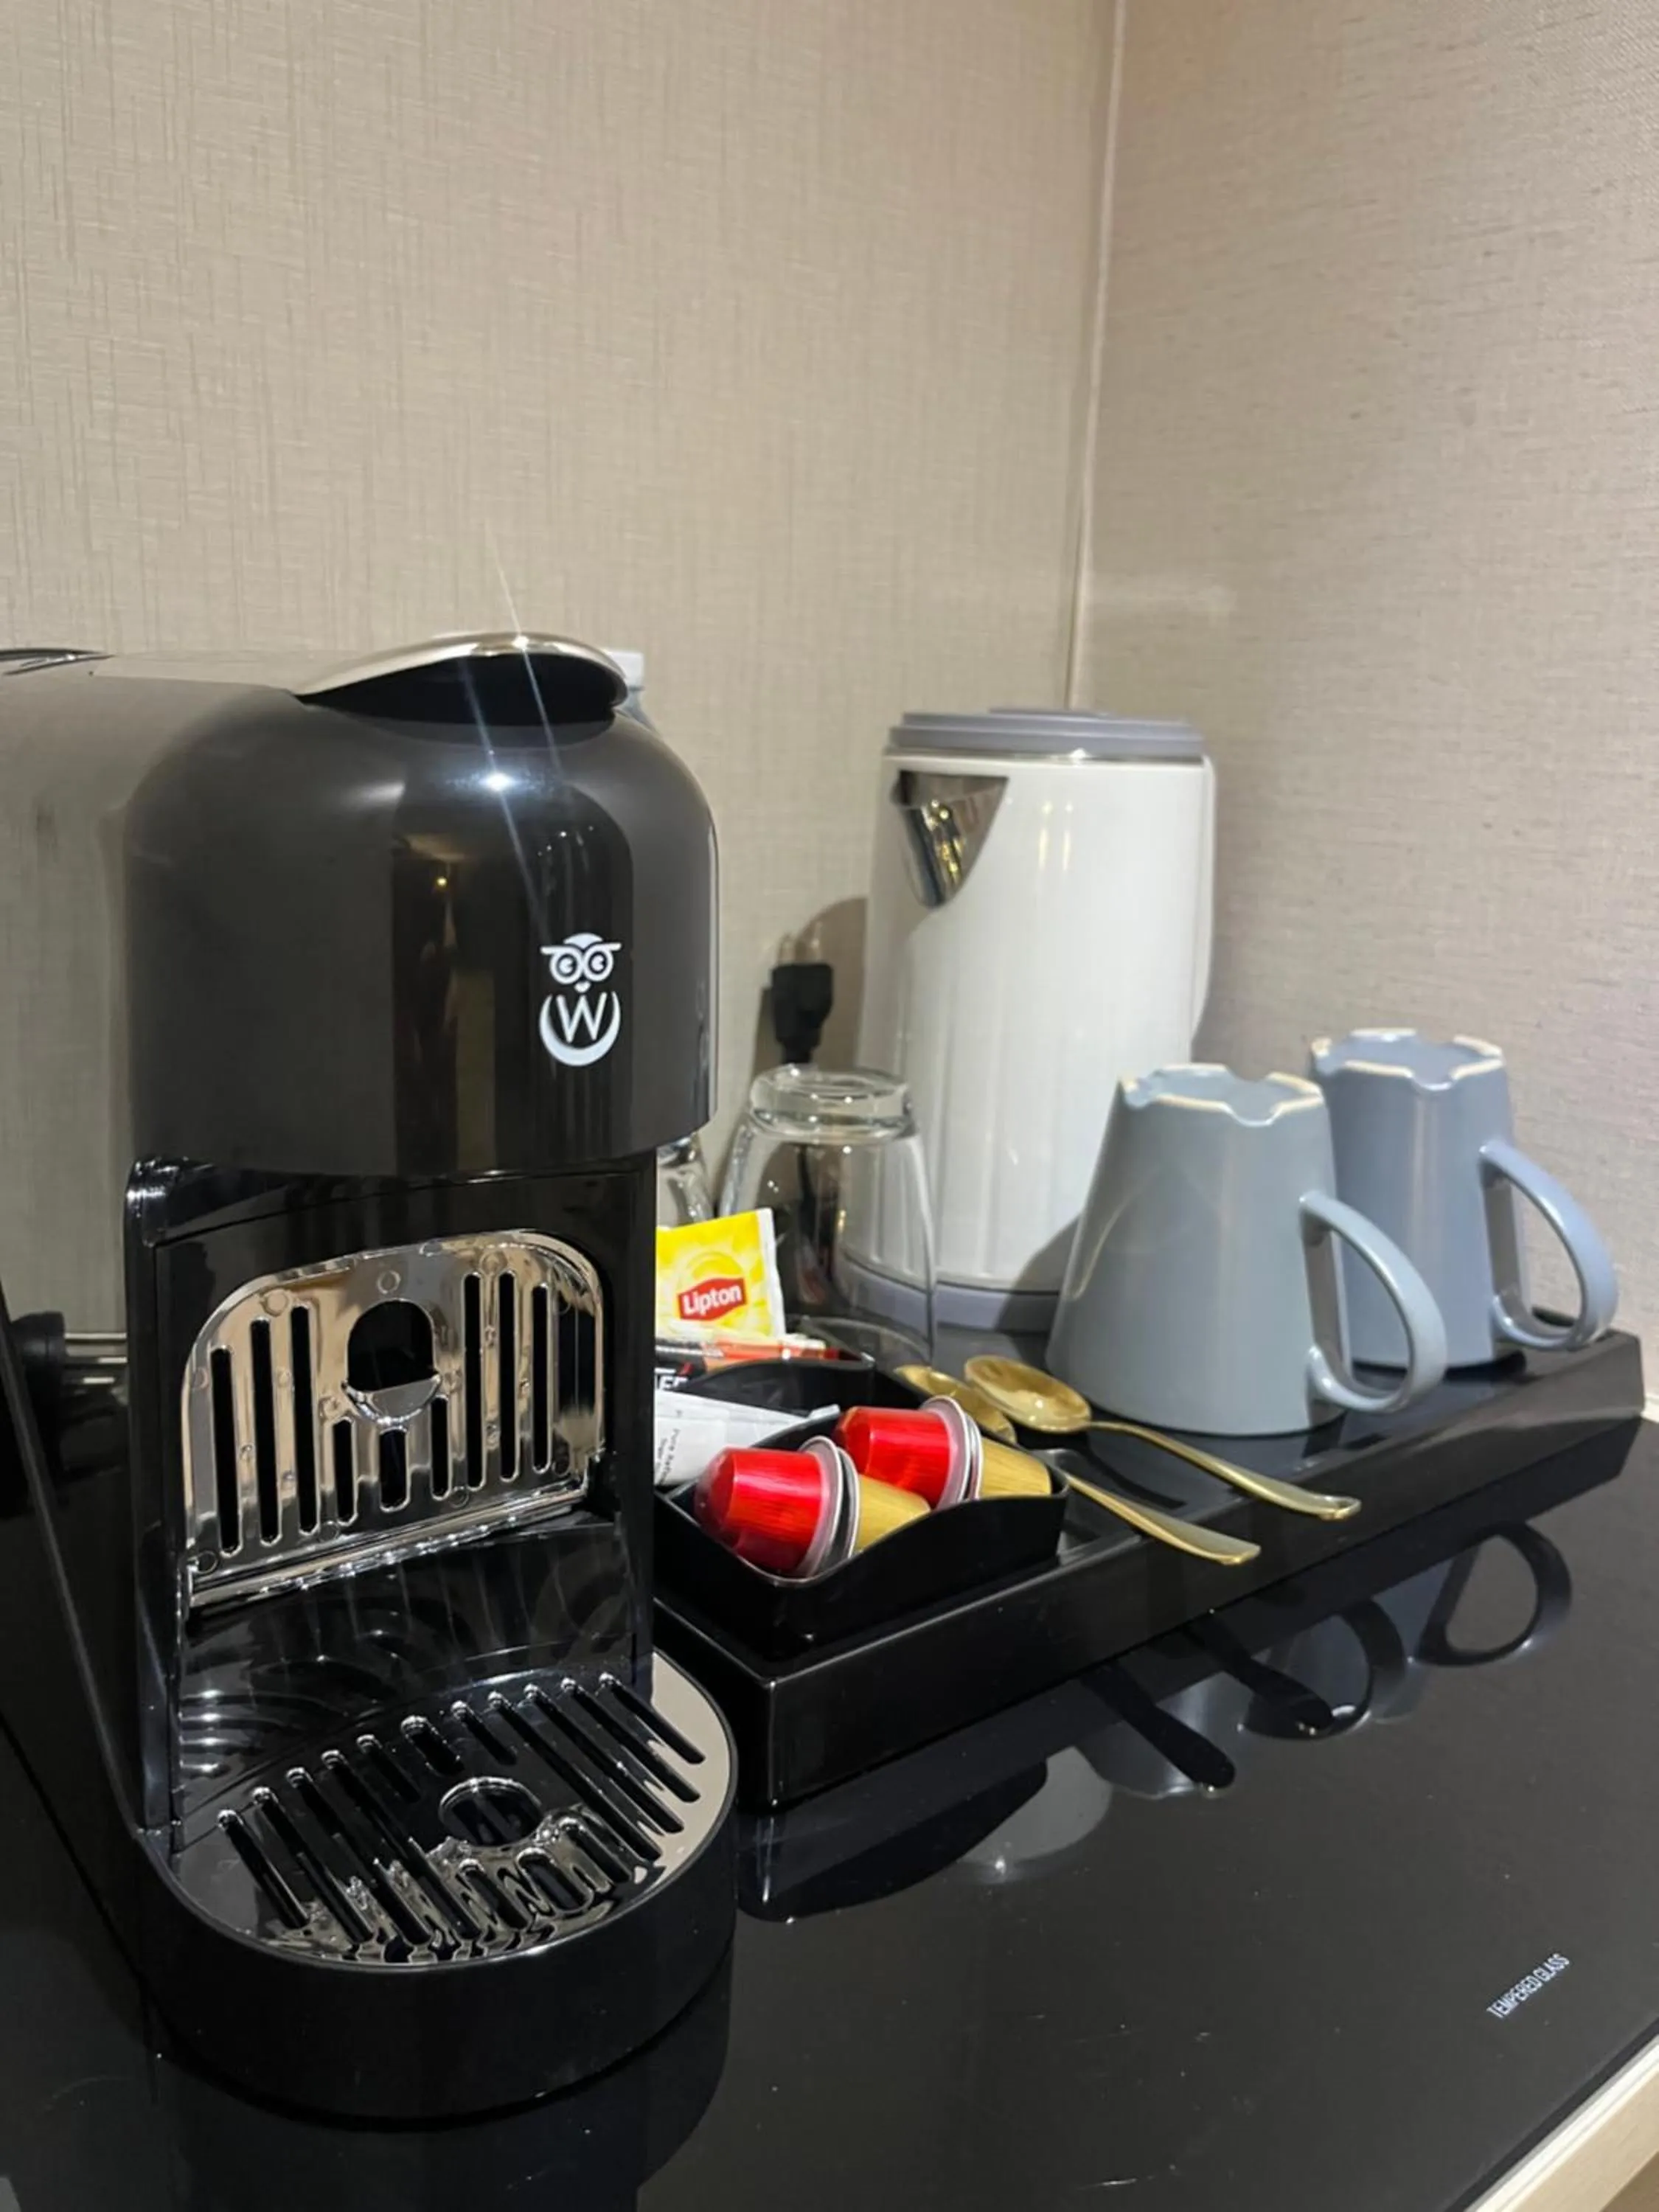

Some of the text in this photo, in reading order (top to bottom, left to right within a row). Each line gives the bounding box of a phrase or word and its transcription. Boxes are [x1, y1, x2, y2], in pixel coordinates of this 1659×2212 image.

[555, 992, 608, 1043] W
[683, 1285, 742, 1316] Lipton
[1486, 1953, 1570, 2018] TEMPERED GLASS
